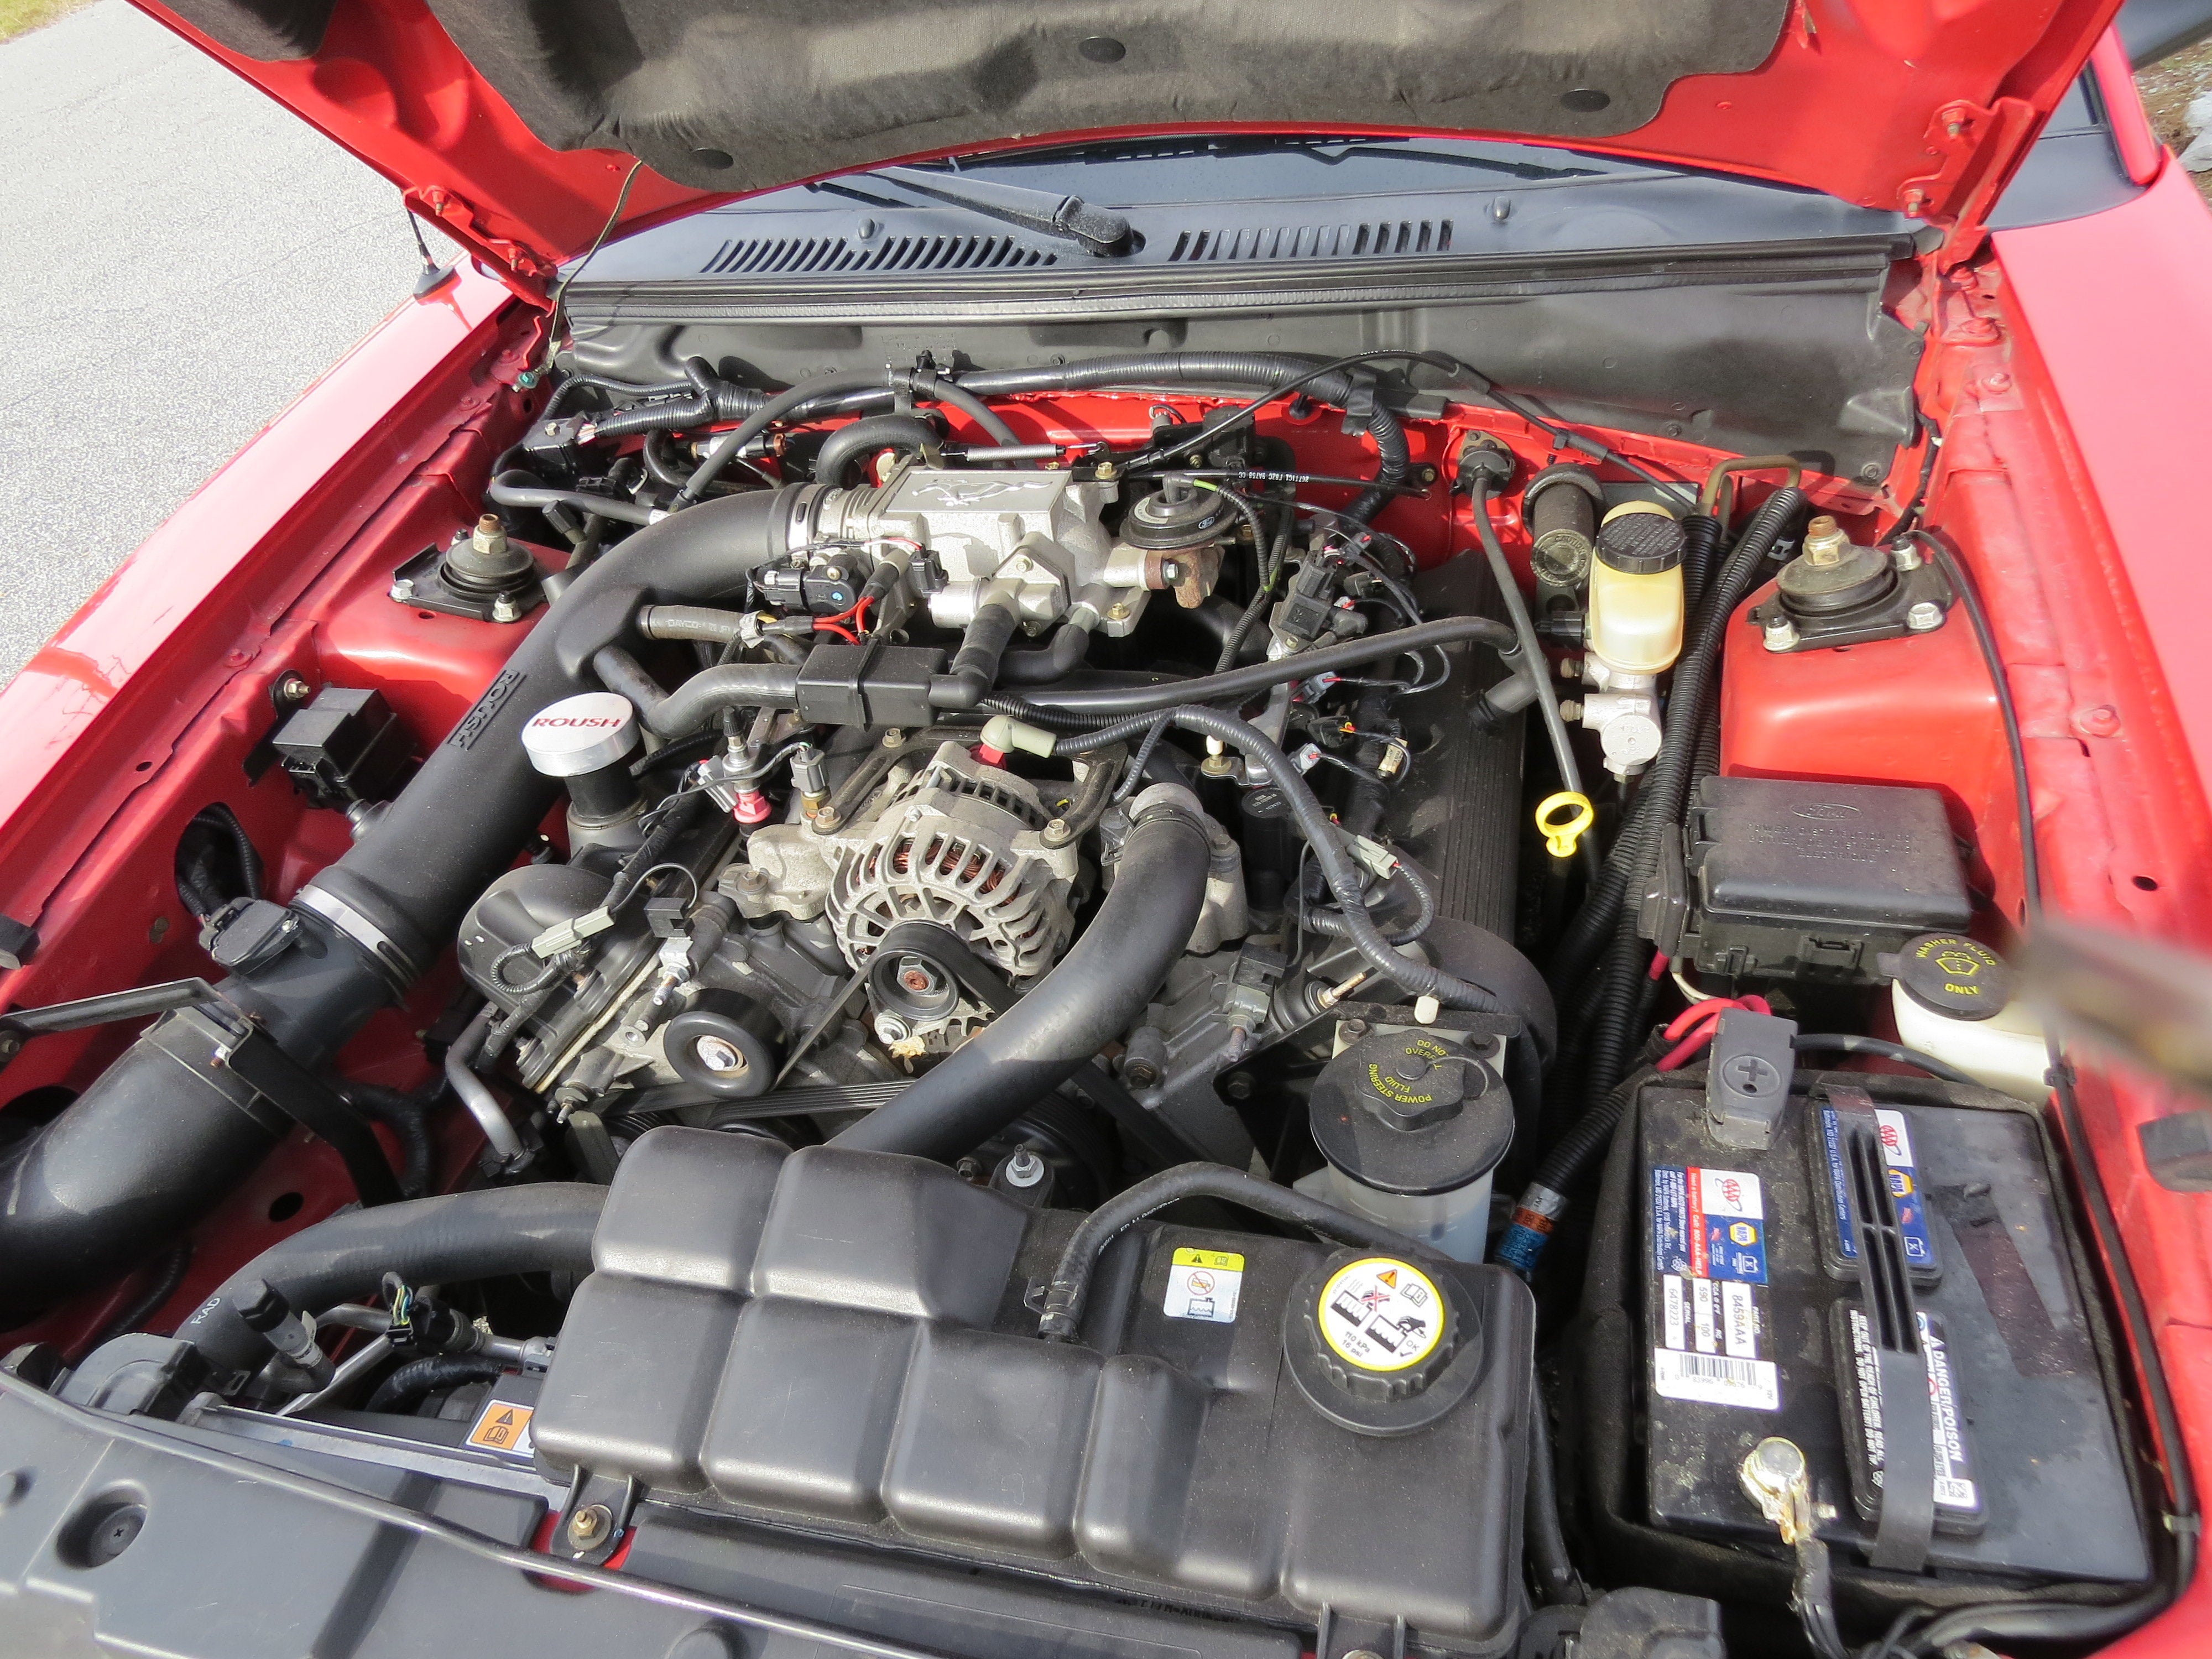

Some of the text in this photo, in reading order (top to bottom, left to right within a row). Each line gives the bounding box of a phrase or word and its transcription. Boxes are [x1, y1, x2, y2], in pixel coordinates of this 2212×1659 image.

[450, 670, 520, 749] ROUSH
[533, 718, 624, 728] ROUSH
[1747, 823, 1790, 834] POWER
[1915, 938, 1996, 966] WASHER FLUID
[1944, 983, 1979, 995] ONLY
[1432, 1046, 1448, 1056] NO
[1369, 1063, 1432, 1103] POWER STEERING
[1385, 1076, 1411, 1093] FLUID
[1722, 1180, 1740, 1202] AAA
[1889, 1175, 1904, 1193] NAPA
[1736, 1226, 1748, 1242] NAPA
[1693, 1229, 1702, 1275] 800-AAA-HELP
[1699, 1287, 1709, 1302] 590
[191, 1297, 221, 1324] RAD
[1732, 1295, 1747, 1344] 8459AAA
[1859, 1315, 1869, 1331] KEEP
[1701, 1323, 1710, 1337] 100
[1860, 1332, 1870, 1344] OUT
[1342, 1339, 1363, 1357] 16 psi
[1345, 1331, 1370, 1353] 110 kPa
[1406, 1340, 1420, 1351] OK
[1855, 1357, 1864, 1366] DO
[1863, 1353, 1872, 1365] THE
[1856, 1366, 1865, 1380] NOT
[1865, 1366, 1875, 1386] REACH
[1859, 1380, 1868, 1397] OPEN
[1868, 1387, 1877, 1395] OF
[1932, 1350, 1962, 1462] DANGER/POISON
[1865, 1428, 1873, 1438] DO
[1874, 1431, 1884, 1449] READ
[1865, 1439, 1875, 1453] NOT
[1876, 1450, 1885, 1462] ALL
